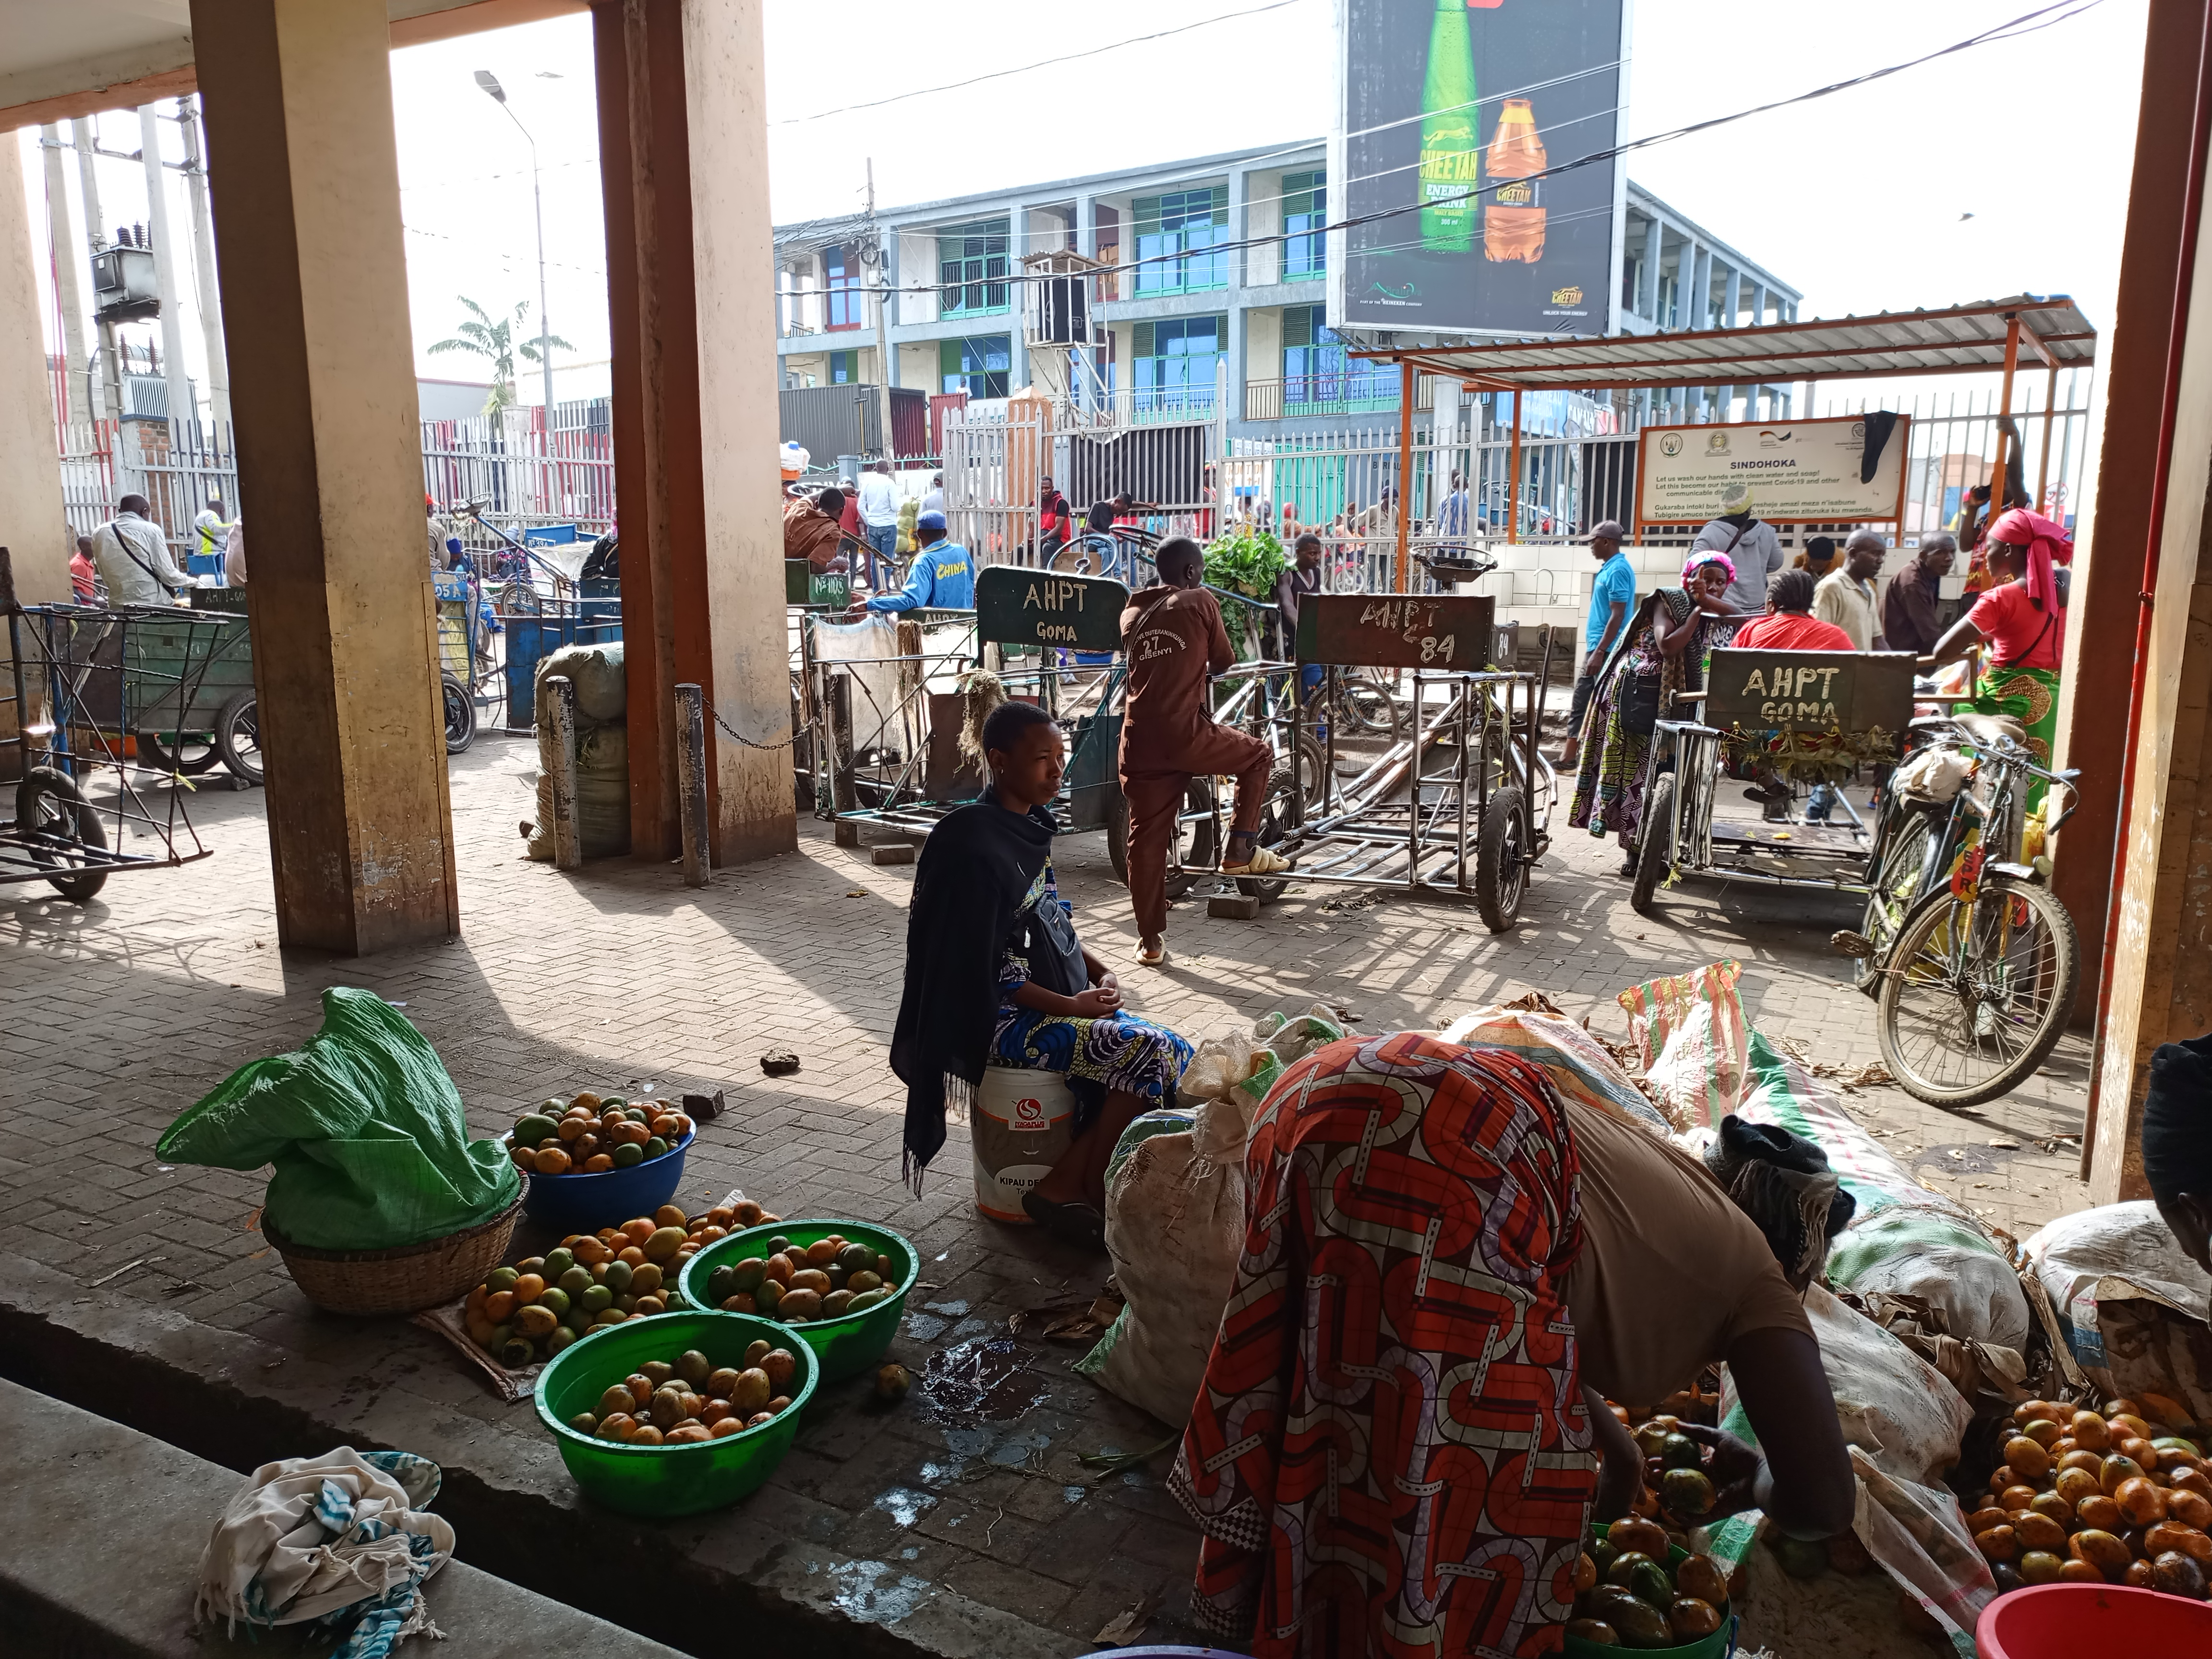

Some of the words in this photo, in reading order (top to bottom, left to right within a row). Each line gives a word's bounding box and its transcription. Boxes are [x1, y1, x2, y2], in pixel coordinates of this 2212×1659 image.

[1419, 149, 1478, 180] CHEETAH
[1426, 184, 1469, 196] ENERGY
[1496, 189, 1531, 203] CHEETAH
[1551, 291, 1583, 304] CHEETAH
[1730, 459, 1796, 469] SINDOHOKA
[937, 561, 968, 580] CHINA
[1023, 580, 1088, 613] AHPT
[1037, 621, 1078, 642] GOMA
[1143, 636, 1159, 653] 27
[1498, 633, 1509, 660] 84
[1139, 647, 1172, 661] GISENYI
[1742, 667, 1840, 699] AHPT
[1761, 702, 1839, 725] GOMA
[999, 1177, 1025, 1187] KIPAU
